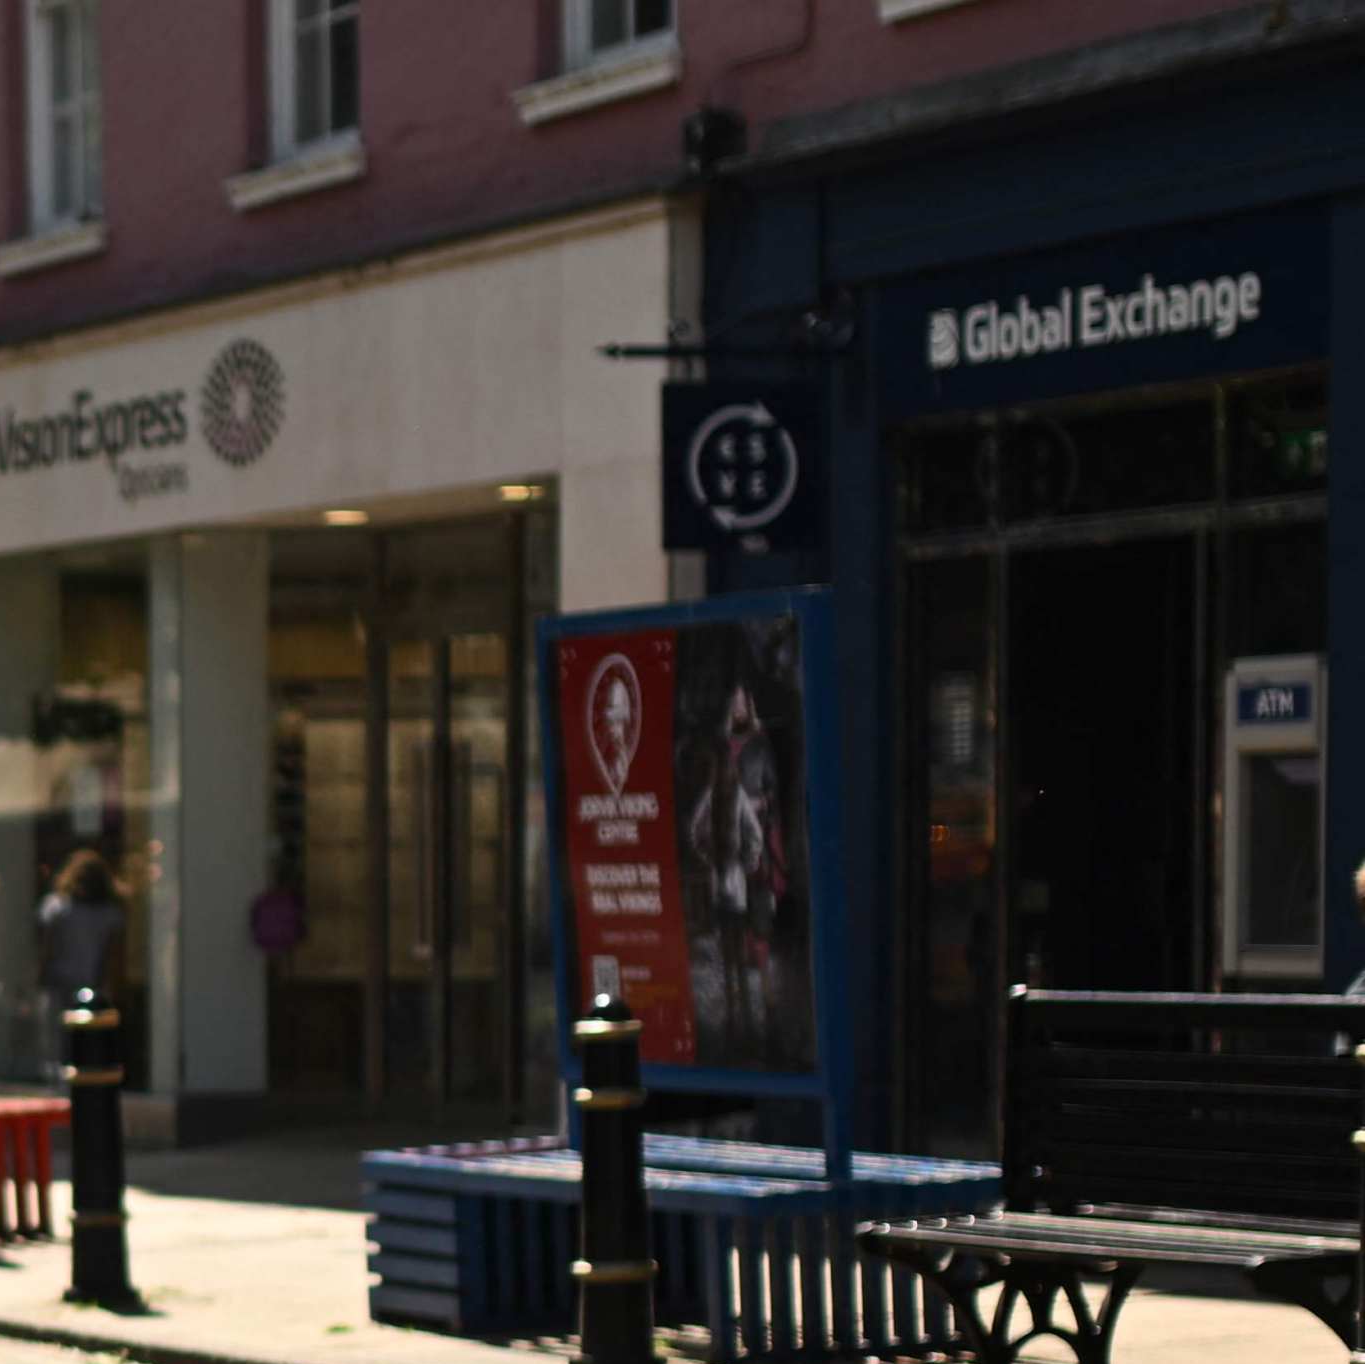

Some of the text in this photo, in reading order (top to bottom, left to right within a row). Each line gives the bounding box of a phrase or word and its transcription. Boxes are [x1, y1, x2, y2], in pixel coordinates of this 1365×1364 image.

[966, 272, 1261, 366] Global Exchange
[1256, 687, 1295, 720] ATM
